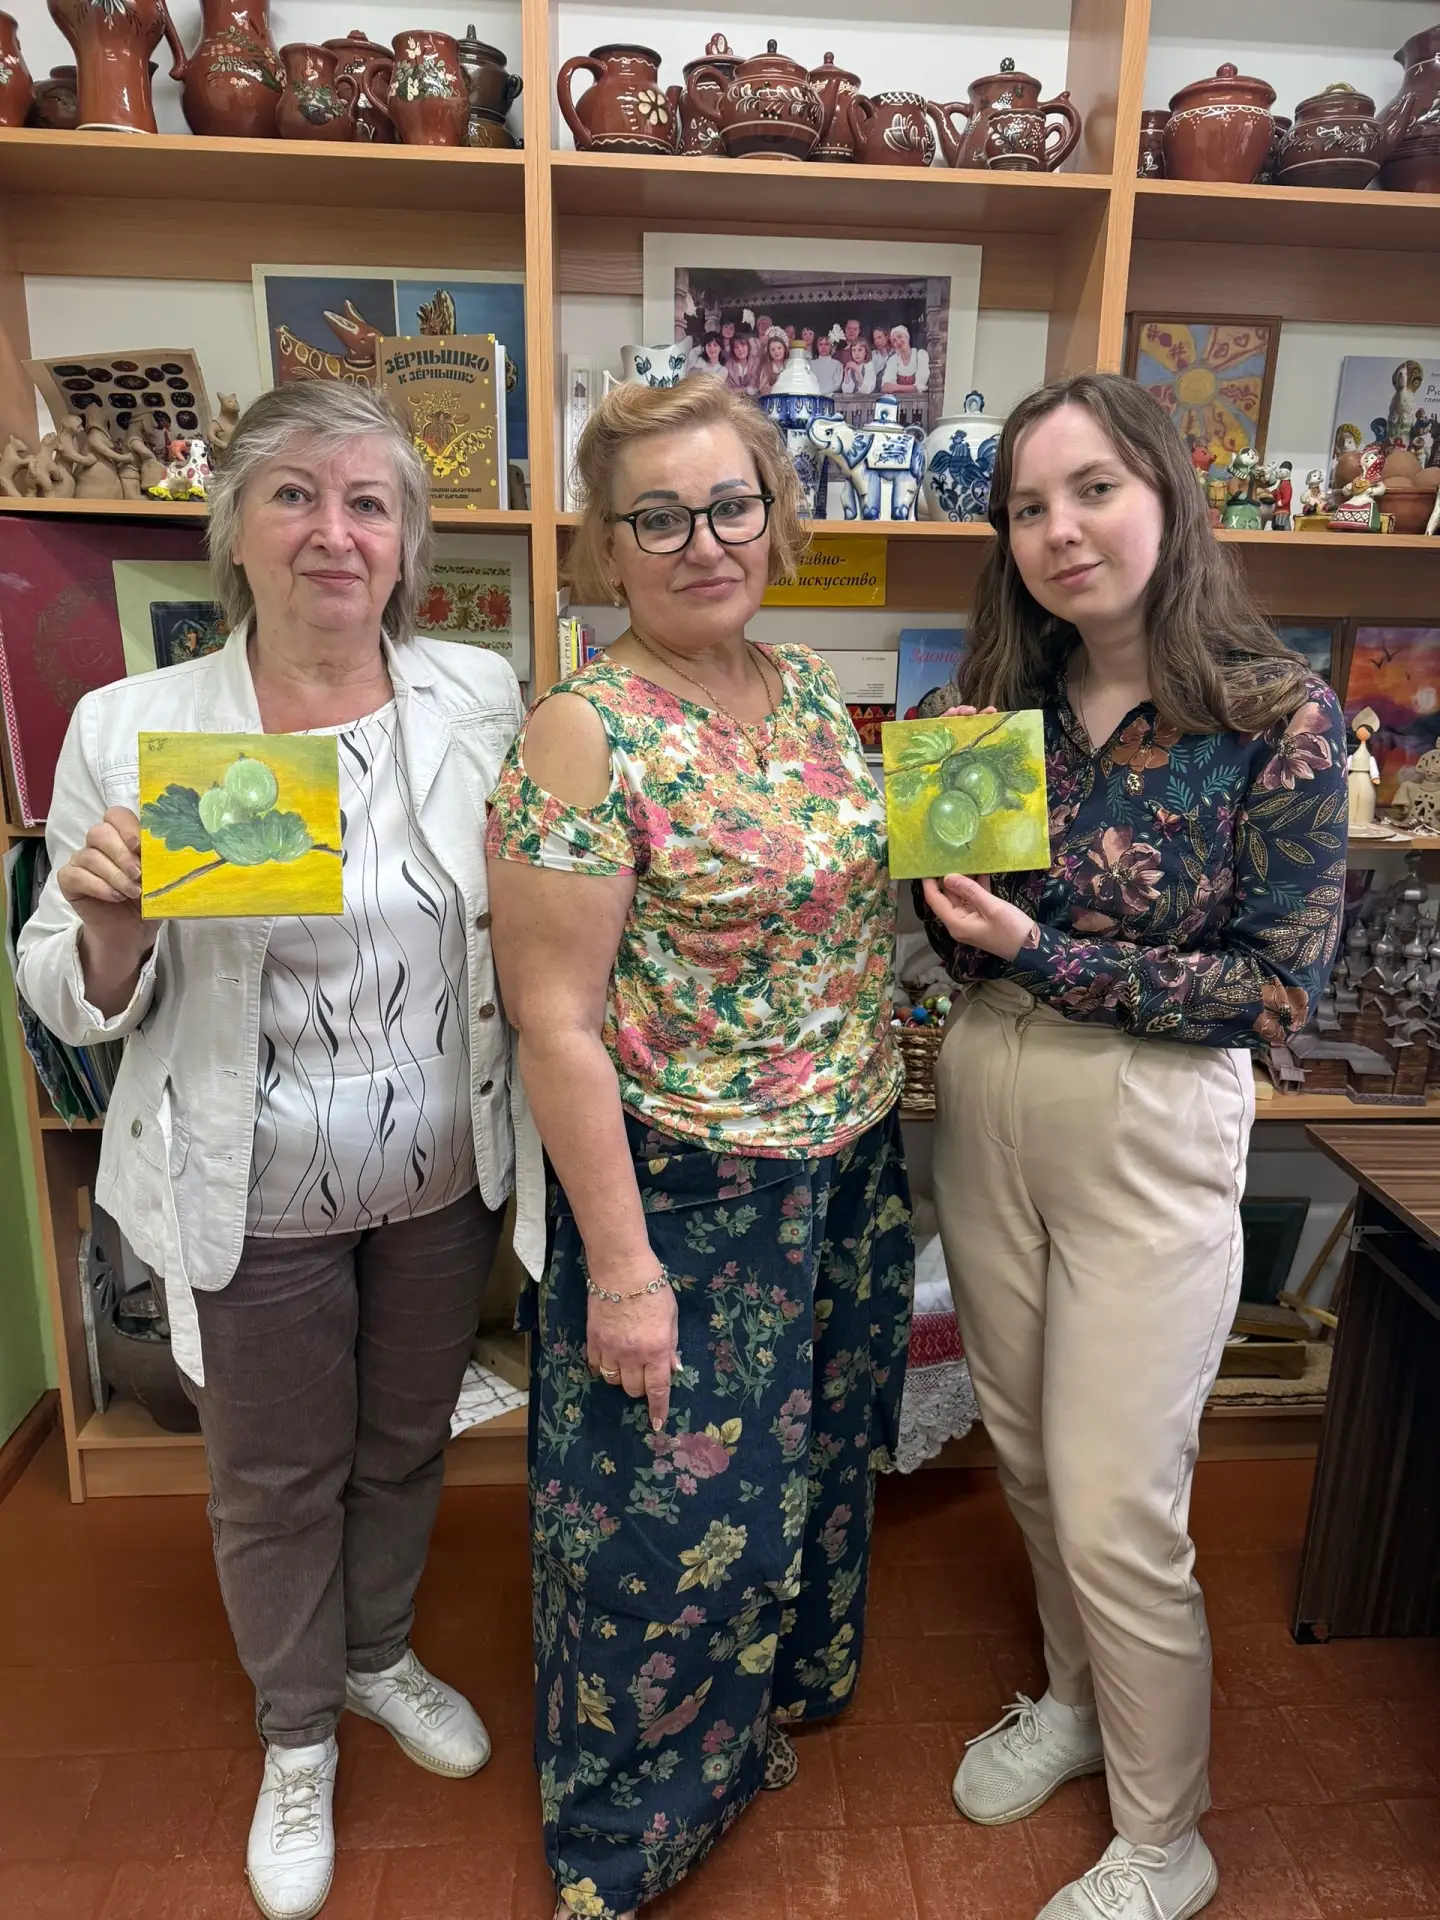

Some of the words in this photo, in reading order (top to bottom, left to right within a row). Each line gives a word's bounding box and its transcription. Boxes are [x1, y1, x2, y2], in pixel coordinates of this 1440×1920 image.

[384, 349, 490, 374] ЗЁРНЫШКО
[398, 374, 407, 384] К
[409, 367, 477, 384] ЗЁРНЫШКУ
[798, 572, 877, 590] искусство
